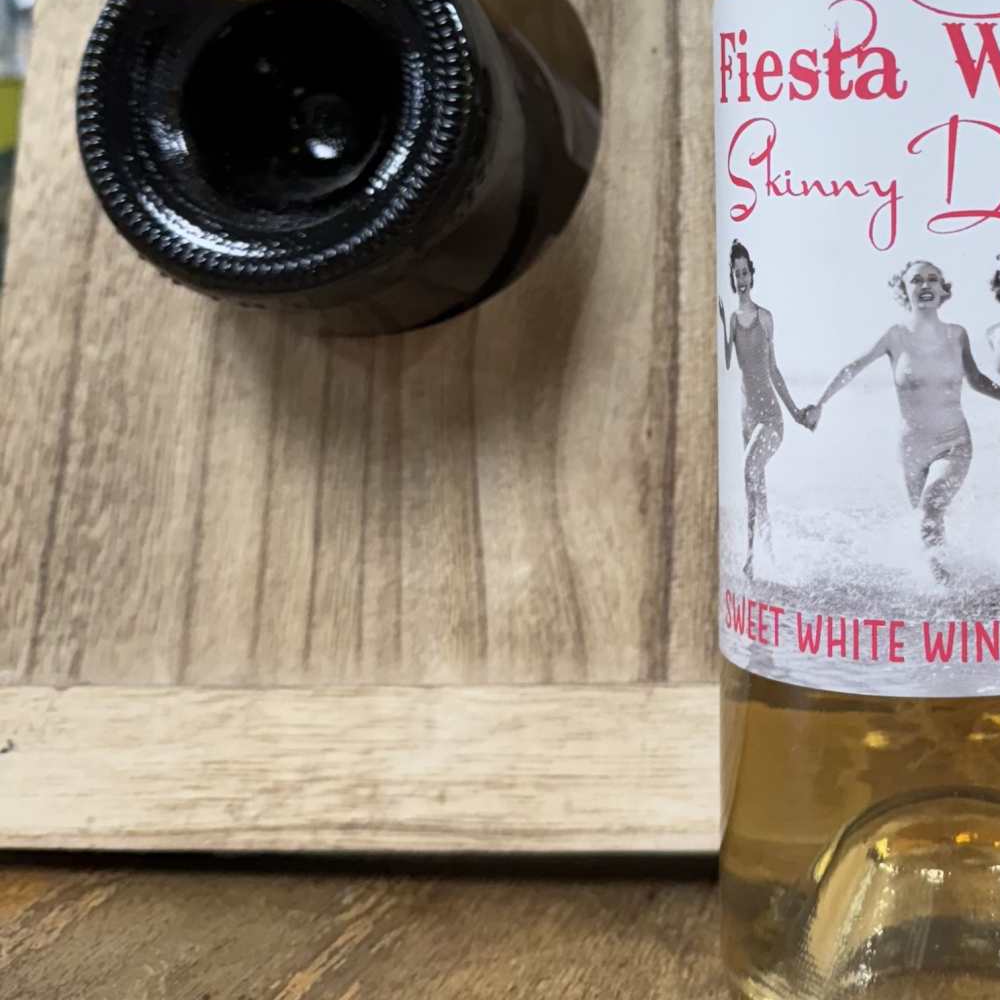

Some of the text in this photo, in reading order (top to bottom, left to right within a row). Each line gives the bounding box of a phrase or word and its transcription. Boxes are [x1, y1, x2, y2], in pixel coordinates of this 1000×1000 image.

[727, 117, 903, 251] Skinny
[725, 589, 784, 647] SWEET
[797, 611, 905, 663] WHITE
